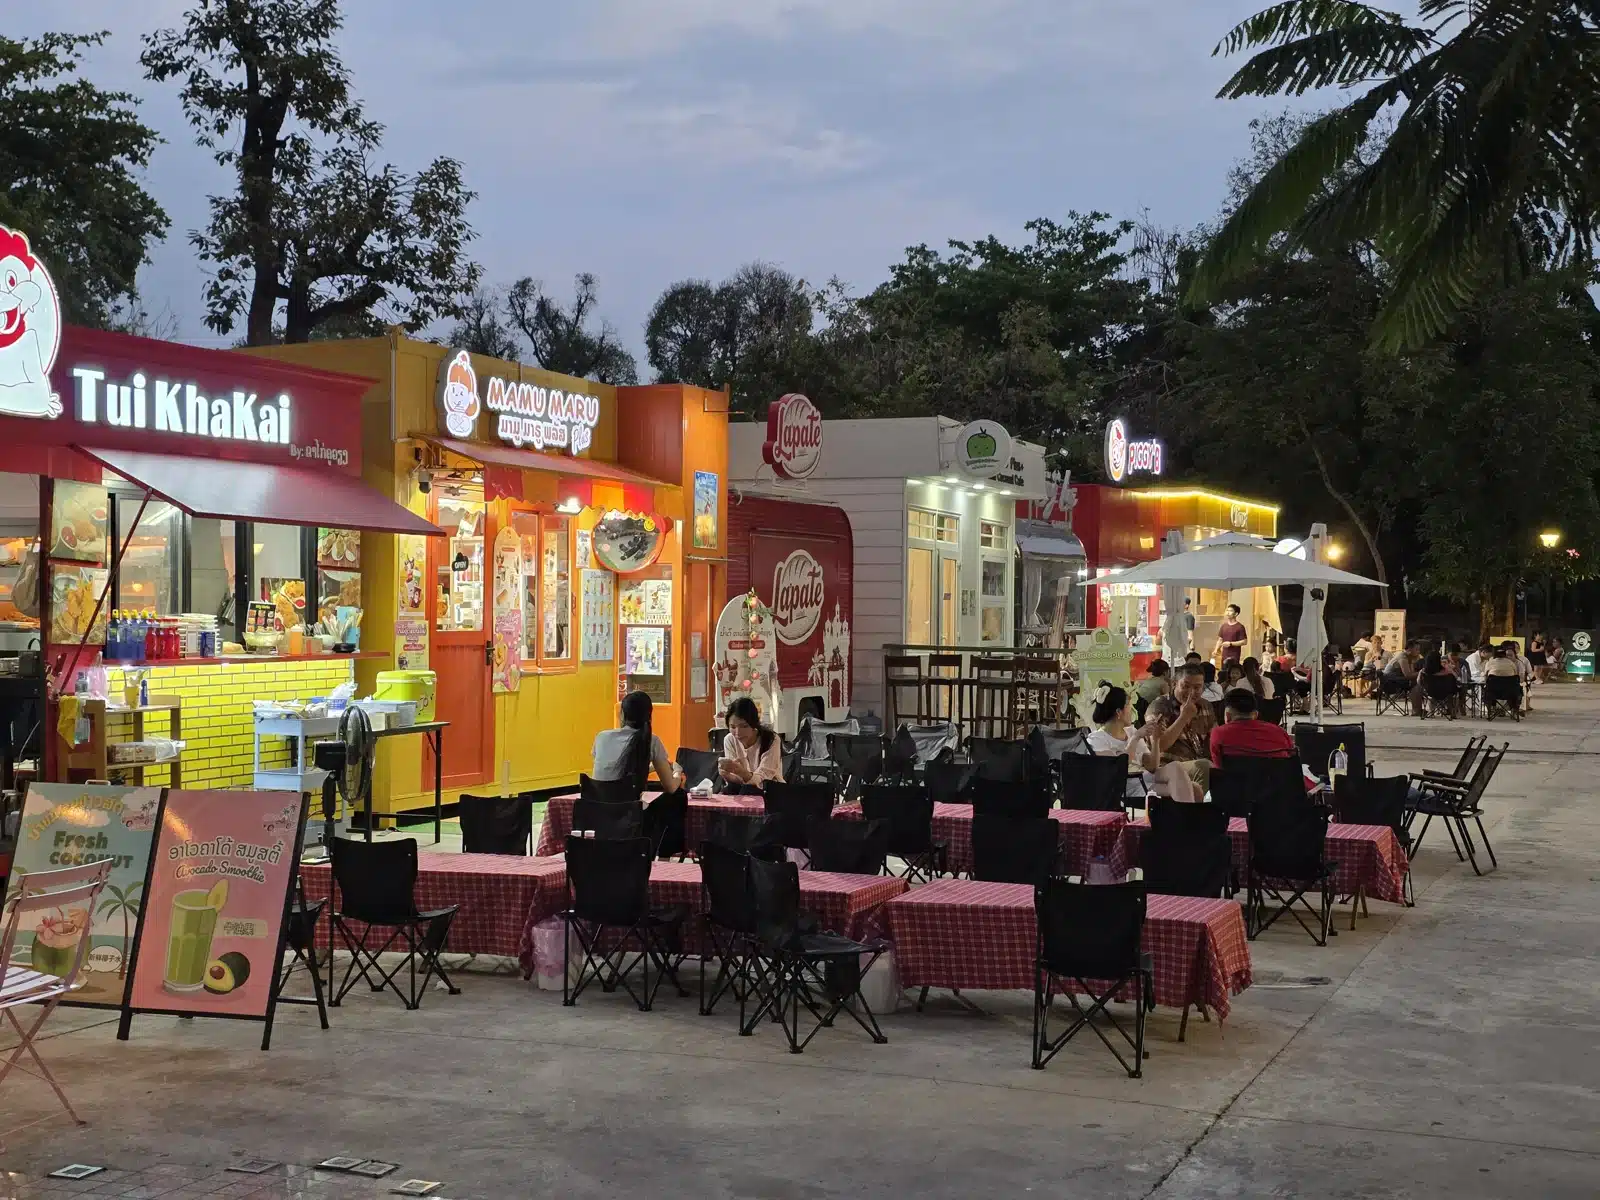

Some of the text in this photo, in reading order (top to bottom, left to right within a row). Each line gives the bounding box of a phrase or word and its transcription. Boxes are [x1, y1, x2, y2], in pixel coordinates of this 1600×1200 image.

[73, 368, 290, 444] Tui KhaKai
[488, 378, 598, 426] MAMU MARU
[290, 443, 304, 460] By:
[775, 407, 821, 461] Lapate
[773, 566, 822, 627] Lapate
[53, 831, 108, 849] Fresh
[176, 860, 265, 883] Avocado Smoothie
